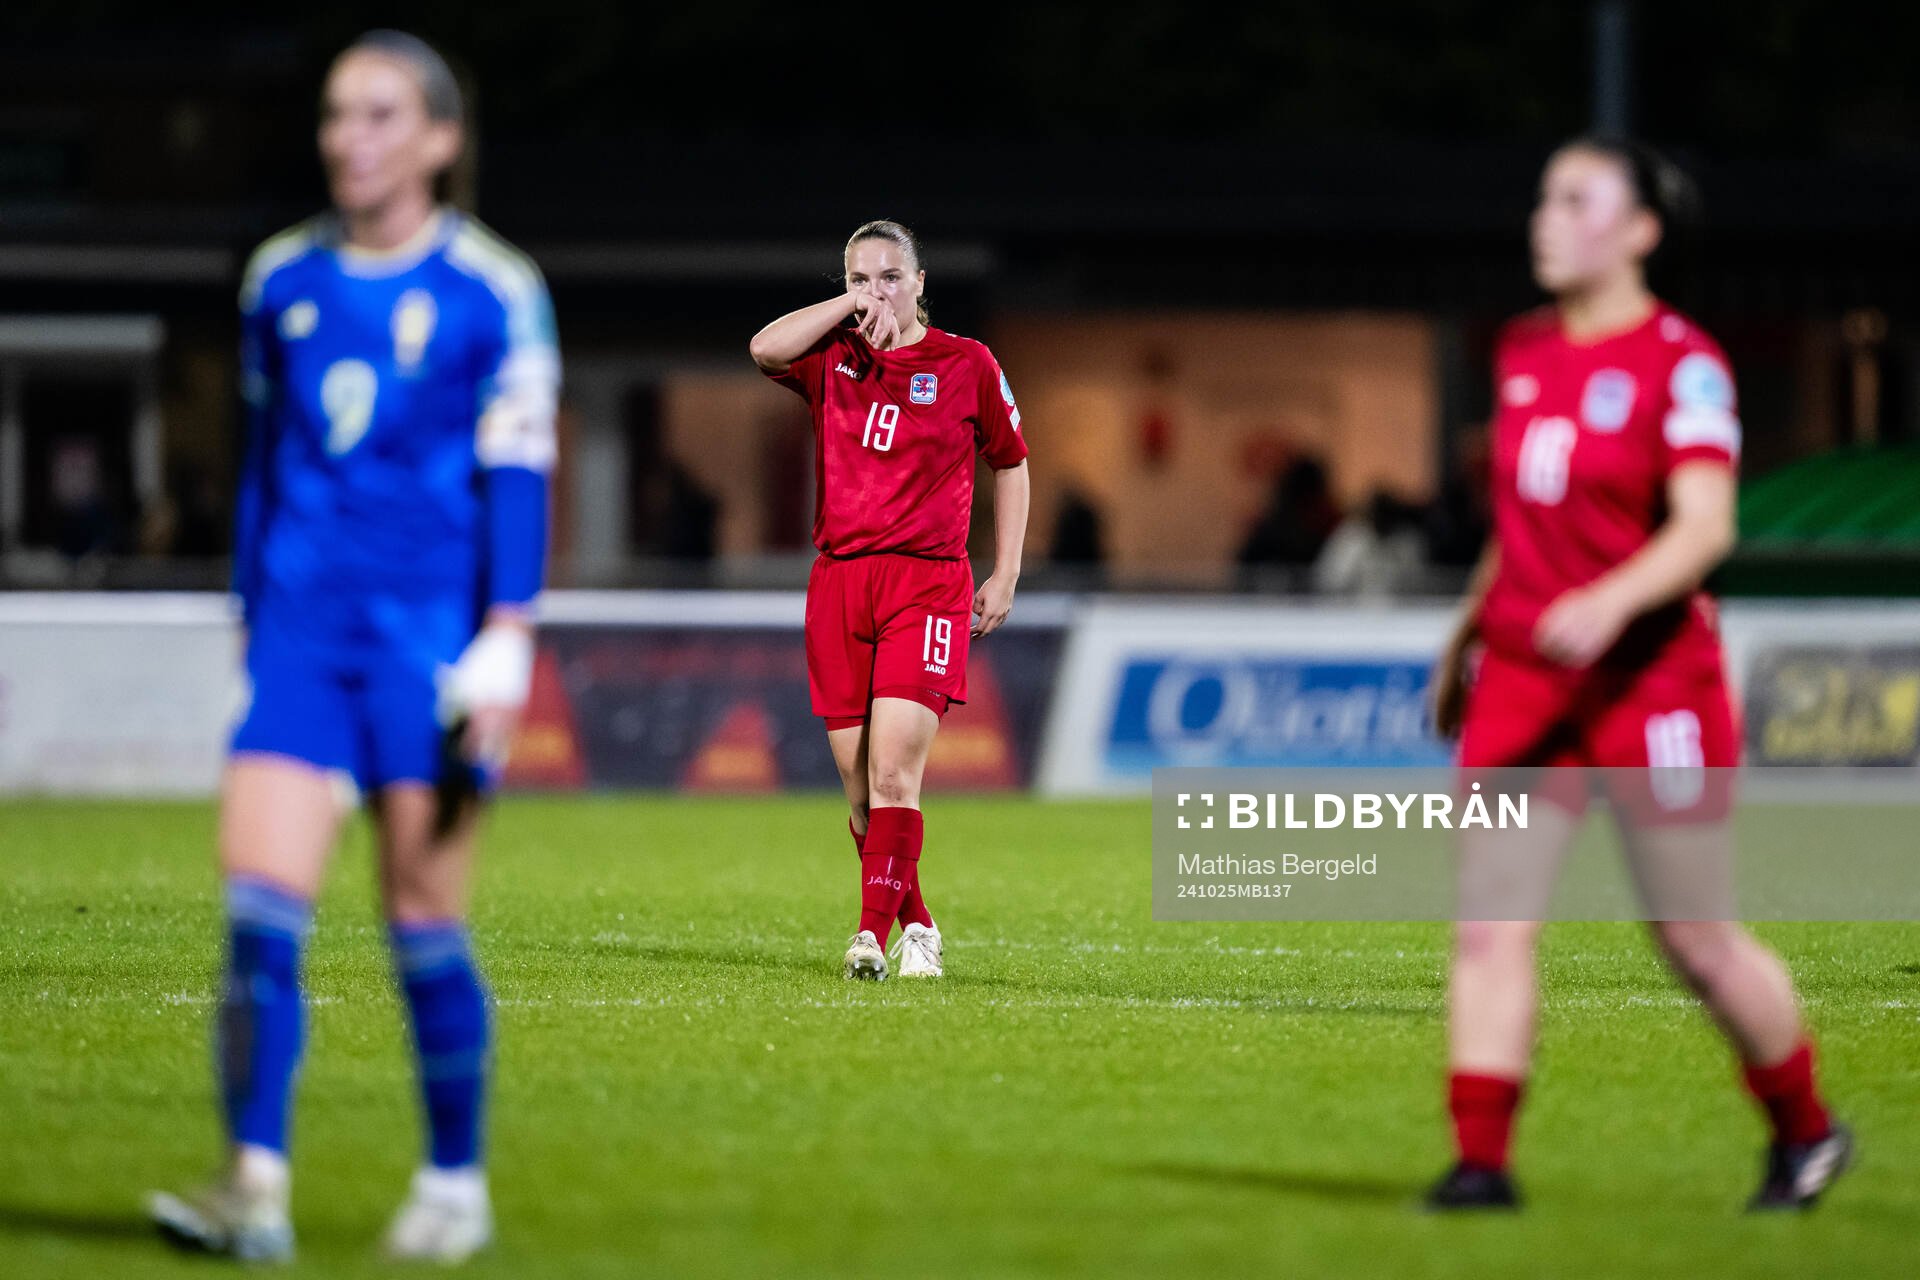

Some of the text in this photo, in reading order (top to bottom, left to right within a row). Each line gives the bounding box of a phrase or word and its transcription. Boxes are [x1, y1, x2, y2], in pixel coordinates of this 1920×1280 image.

[835, 362, 862, 380] JAKO
[322, 360, 377, 457] 9
[862, 401, 900, 452] 19
[923, 614, 952, 666] 19
[924, 663, 947, 675] JAKO
[866, 875, 902, 891] JAKO
